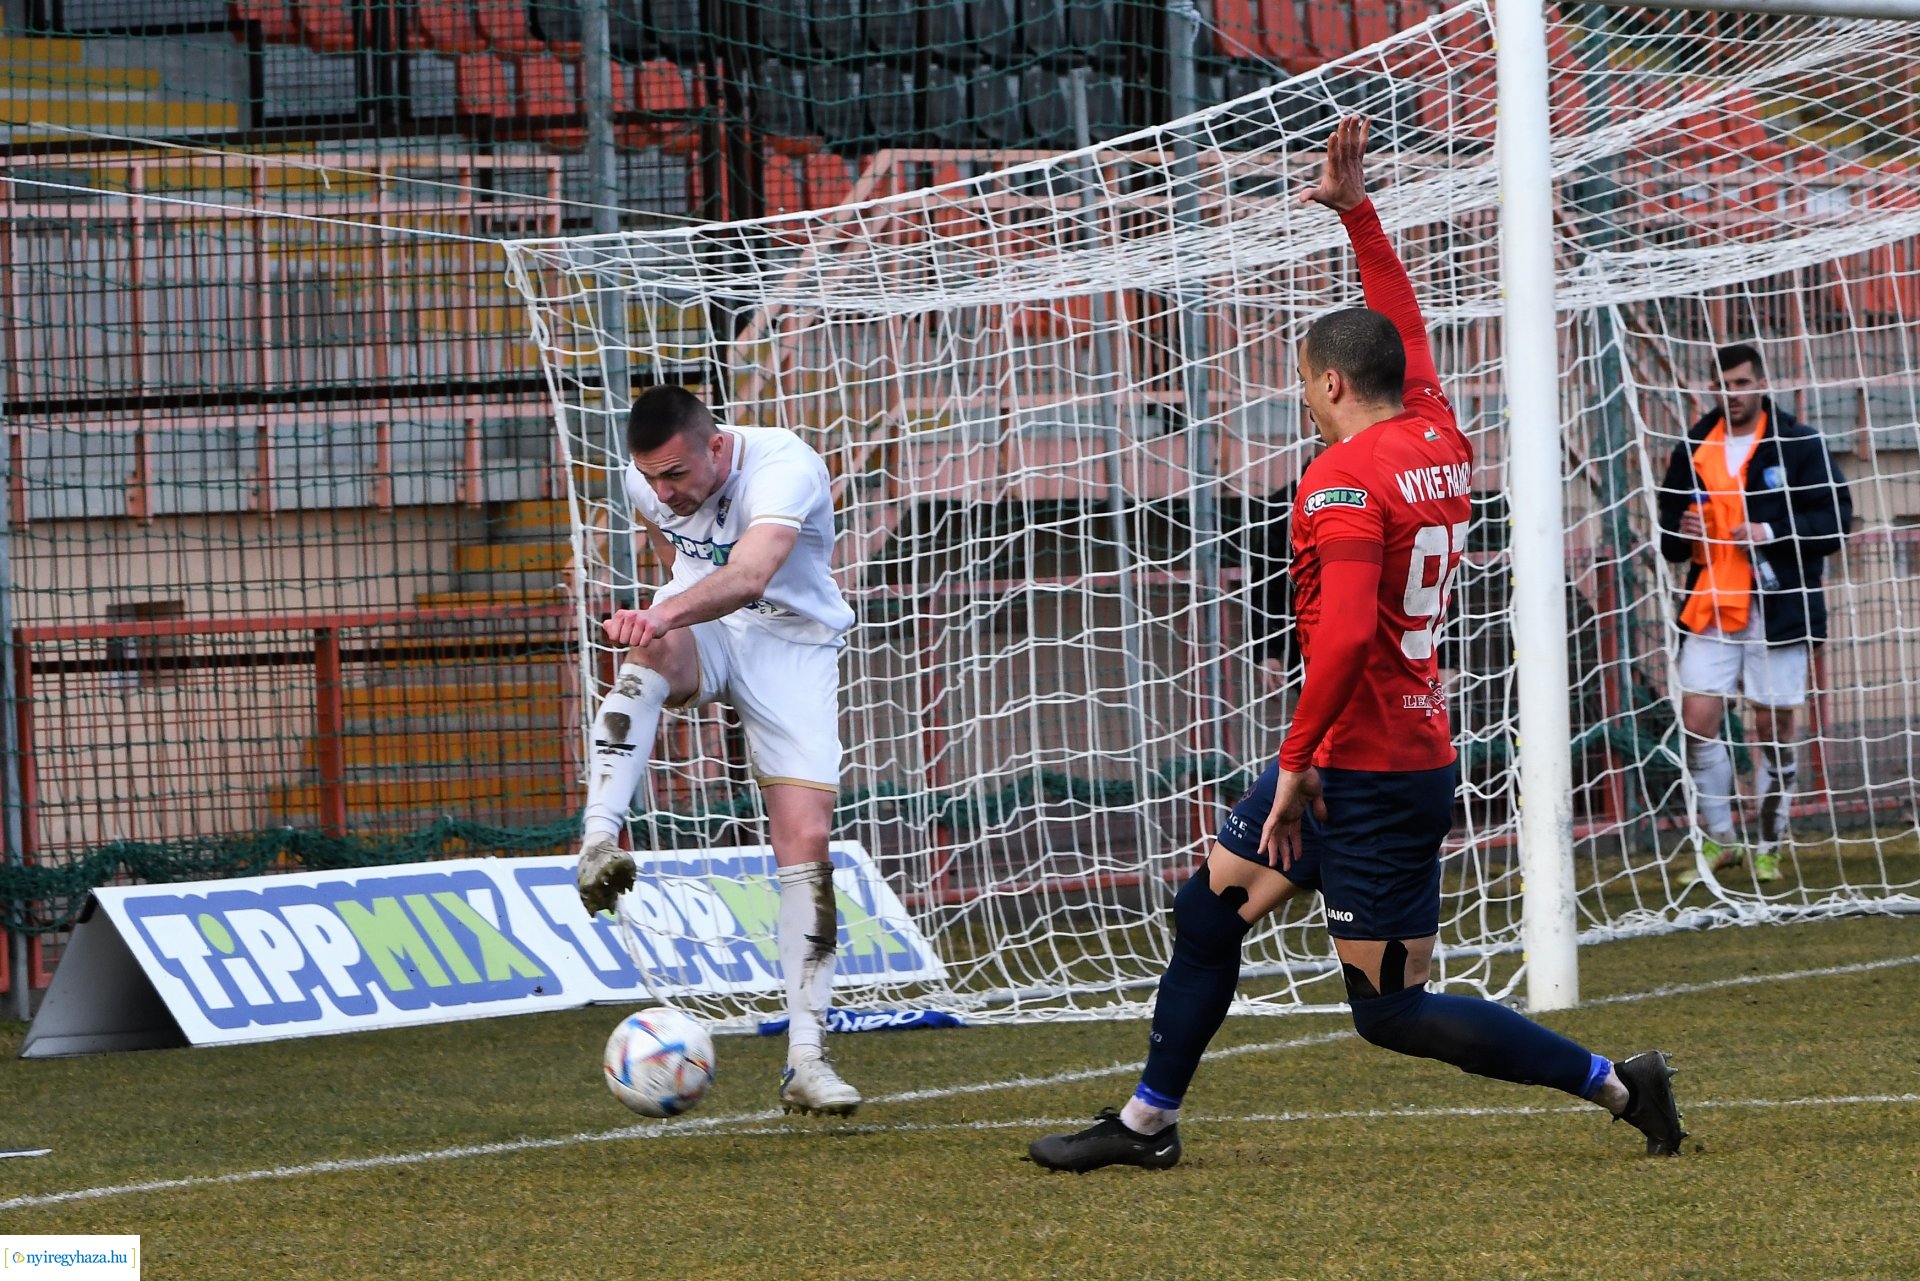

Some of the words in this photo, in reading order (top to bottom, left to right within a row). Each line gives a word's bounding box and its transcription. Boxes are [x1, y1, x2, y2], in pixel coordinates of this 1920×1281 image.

[1305, 490, 1363, 512] PPMIX
[1395, 466, 1446, 504] MYKE
[530, 868, 908, 972] TiPPMX
